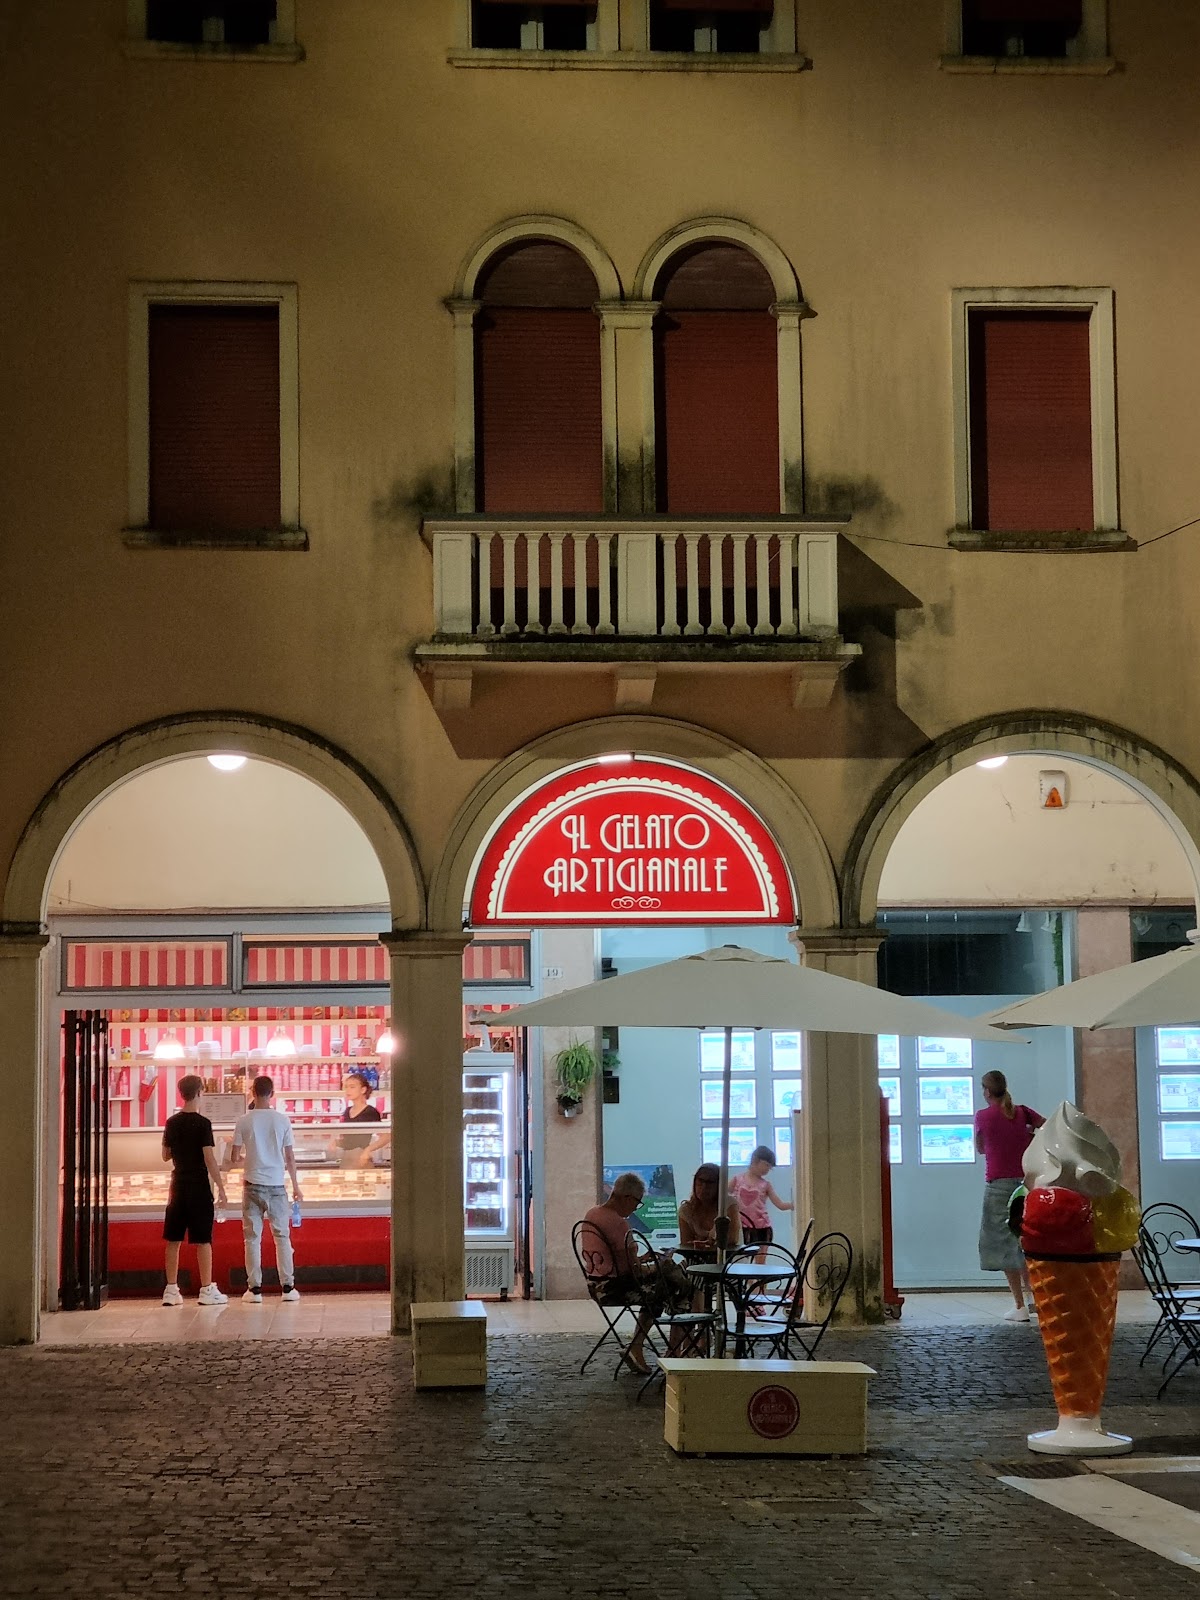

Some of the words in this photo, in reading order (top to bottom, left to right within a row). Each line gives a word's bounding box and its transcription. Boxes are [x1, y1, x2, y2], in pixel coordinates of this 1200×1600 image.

[560, 814, 591, 854] IL
[600, 813, 710, 853] GELATO
[543, 857, 728, 897] ARTIGIANALE
[547, 968, 558, 977] 19
